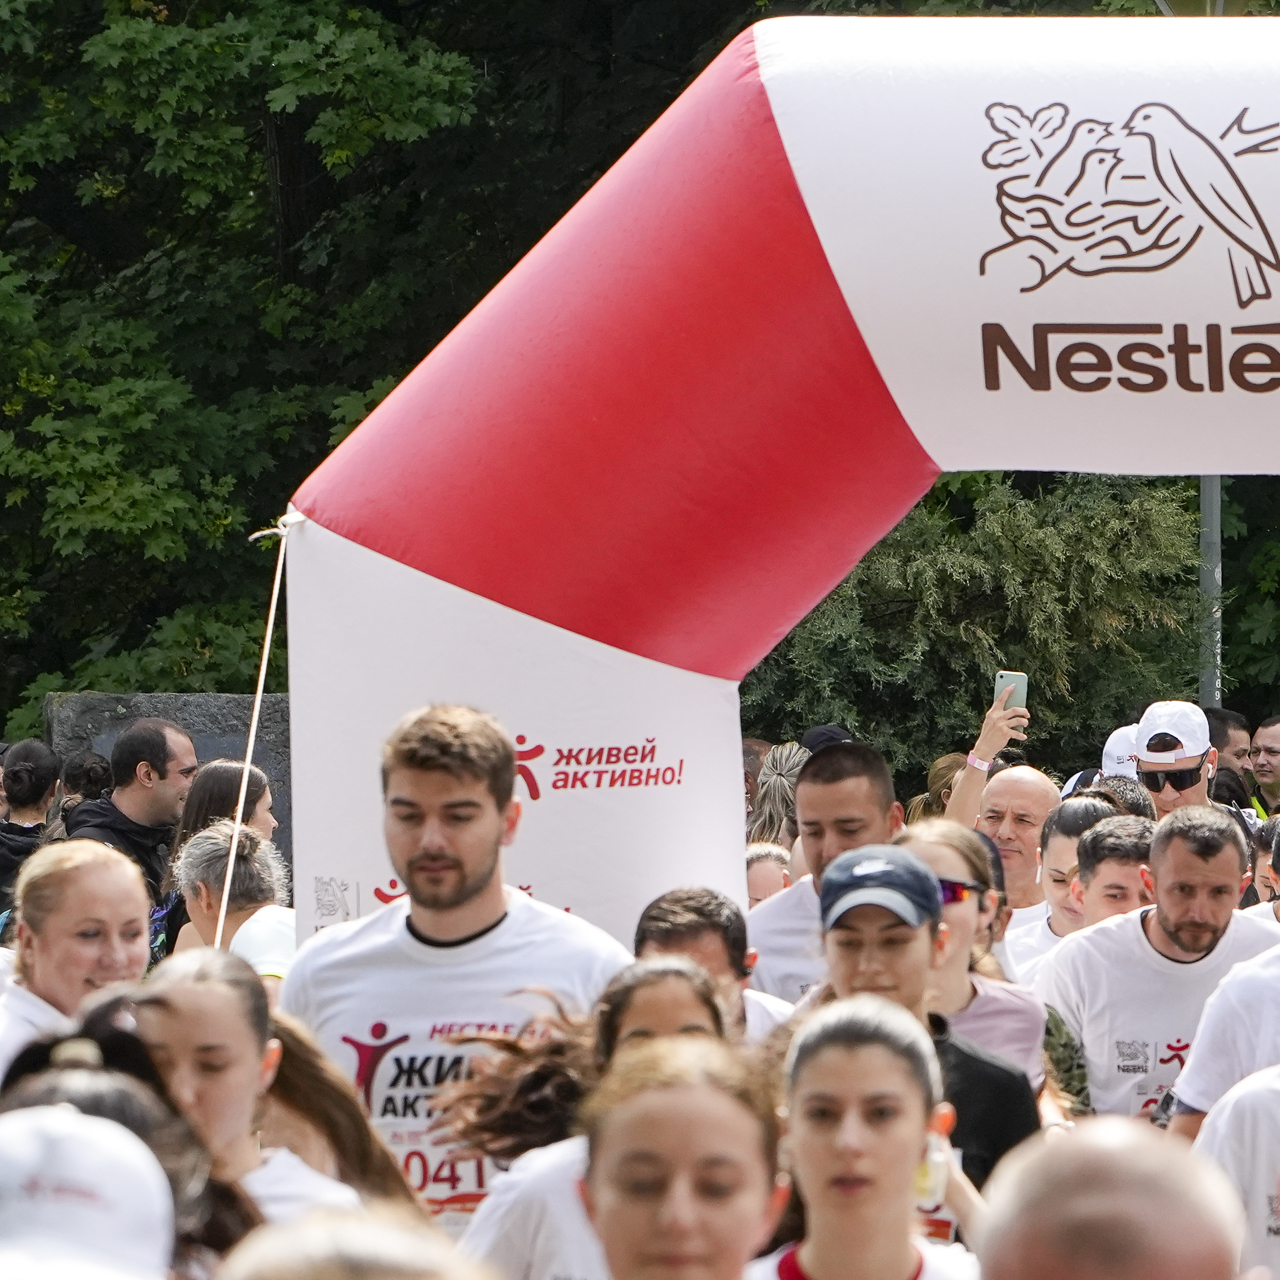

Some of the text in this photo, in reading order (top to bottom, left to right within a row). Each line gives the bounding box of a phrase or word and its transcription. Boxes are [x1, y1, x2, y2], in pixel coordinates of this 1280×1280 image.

[553, 737, 656, 767] живей
[552, 759, 684, 790] активно!
[404, 1150, 487, 1191] 041
